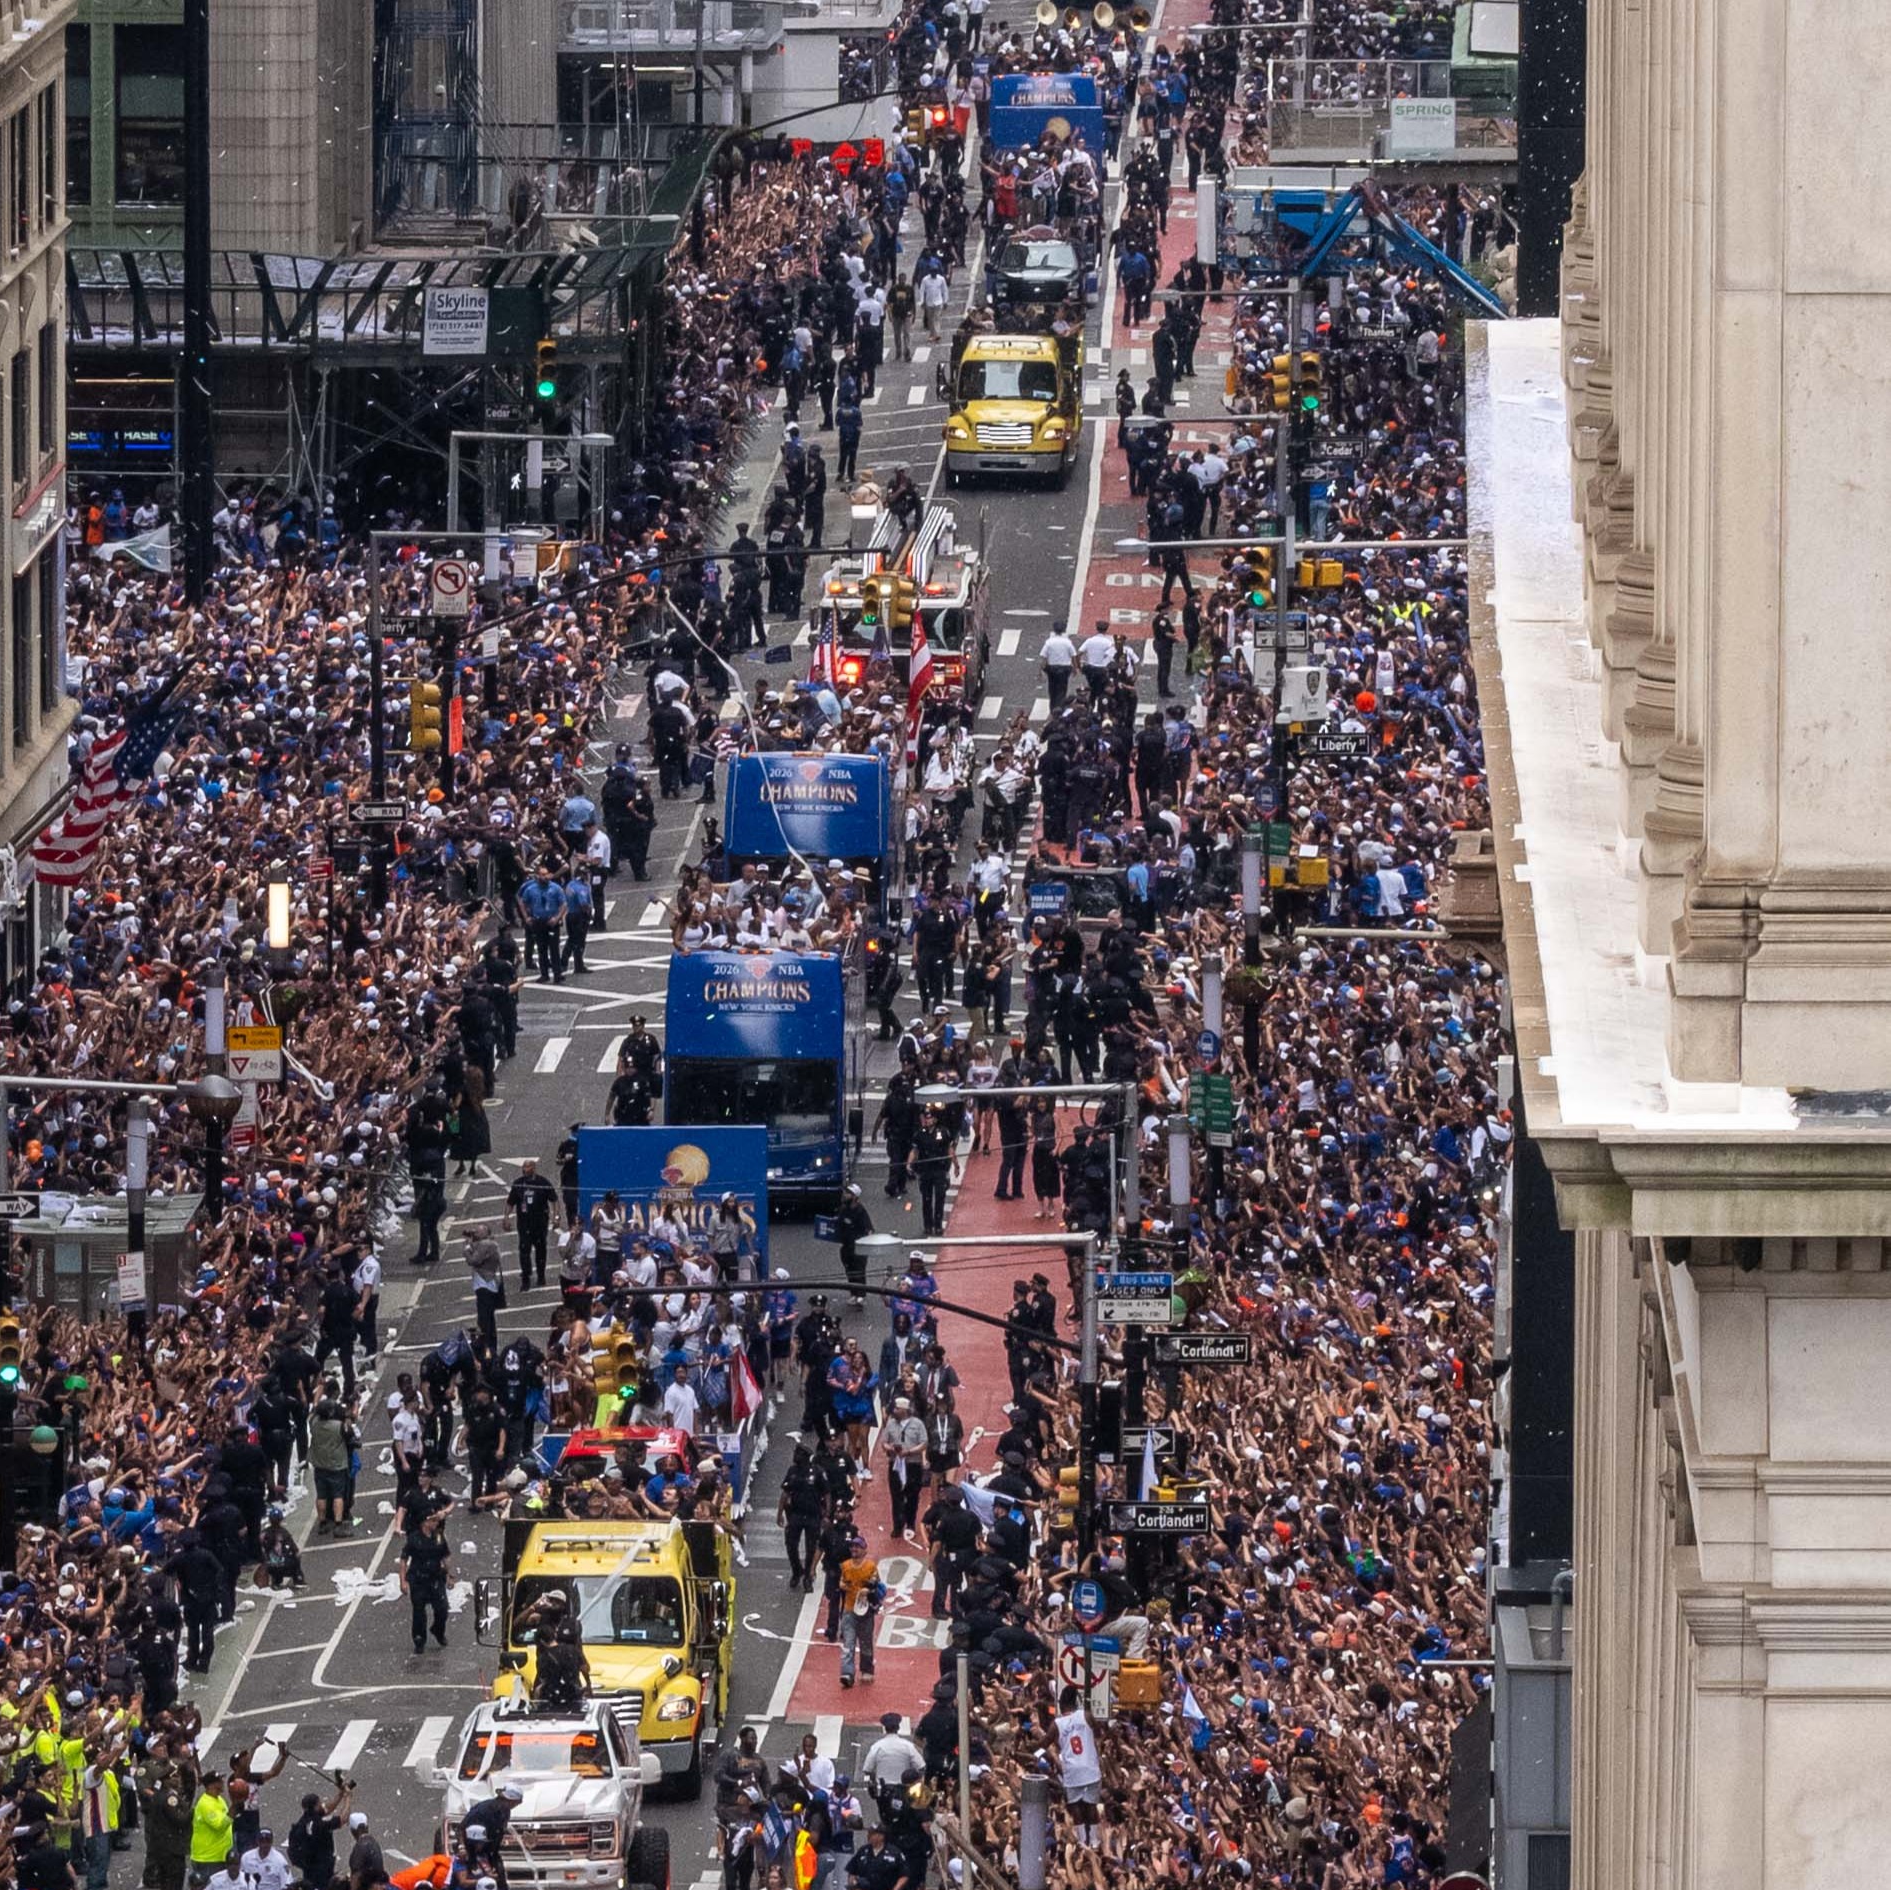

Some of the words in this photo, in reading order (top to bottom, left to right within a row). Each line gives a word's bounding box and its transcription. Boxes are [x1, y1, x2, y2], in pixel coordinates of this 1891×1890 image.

[1011, 93, 1077, 105] CHAMPIONS
[1394, 105, 1453, 116] SPRING
[436, 292, 487, 313] Skyline
[1326, 445, 1355, 459] Cedar
[1319, 737, 1357, 756] Liberty
[769, 768, 793, 779] 2026
[828, 769, 852, 780] NBA
[760, 784, 859, 804] CHAMPIONS
[713, 964, 740, 977] 2026
[778, 966, 804, 978] NBA
[703, 981, 812, 1003] CHAMPIONS
[718, 1003, 739, 1013] NEW
[740, 1003, 763, 1013] YORK
[764, 1004, 797, 1013] KNICKS
[7, 1202, 29, 1212] WAY
[1120, 1275, 1140, 1285] BUS
[1141, 1276, 1165, 1285] LANE
[1141, 1287, 1166, 1296] ONLY
[1181, 1345, 1235, 1358] Cortlandt
[1138, 1514, 1195, 1528] Cortlandt
